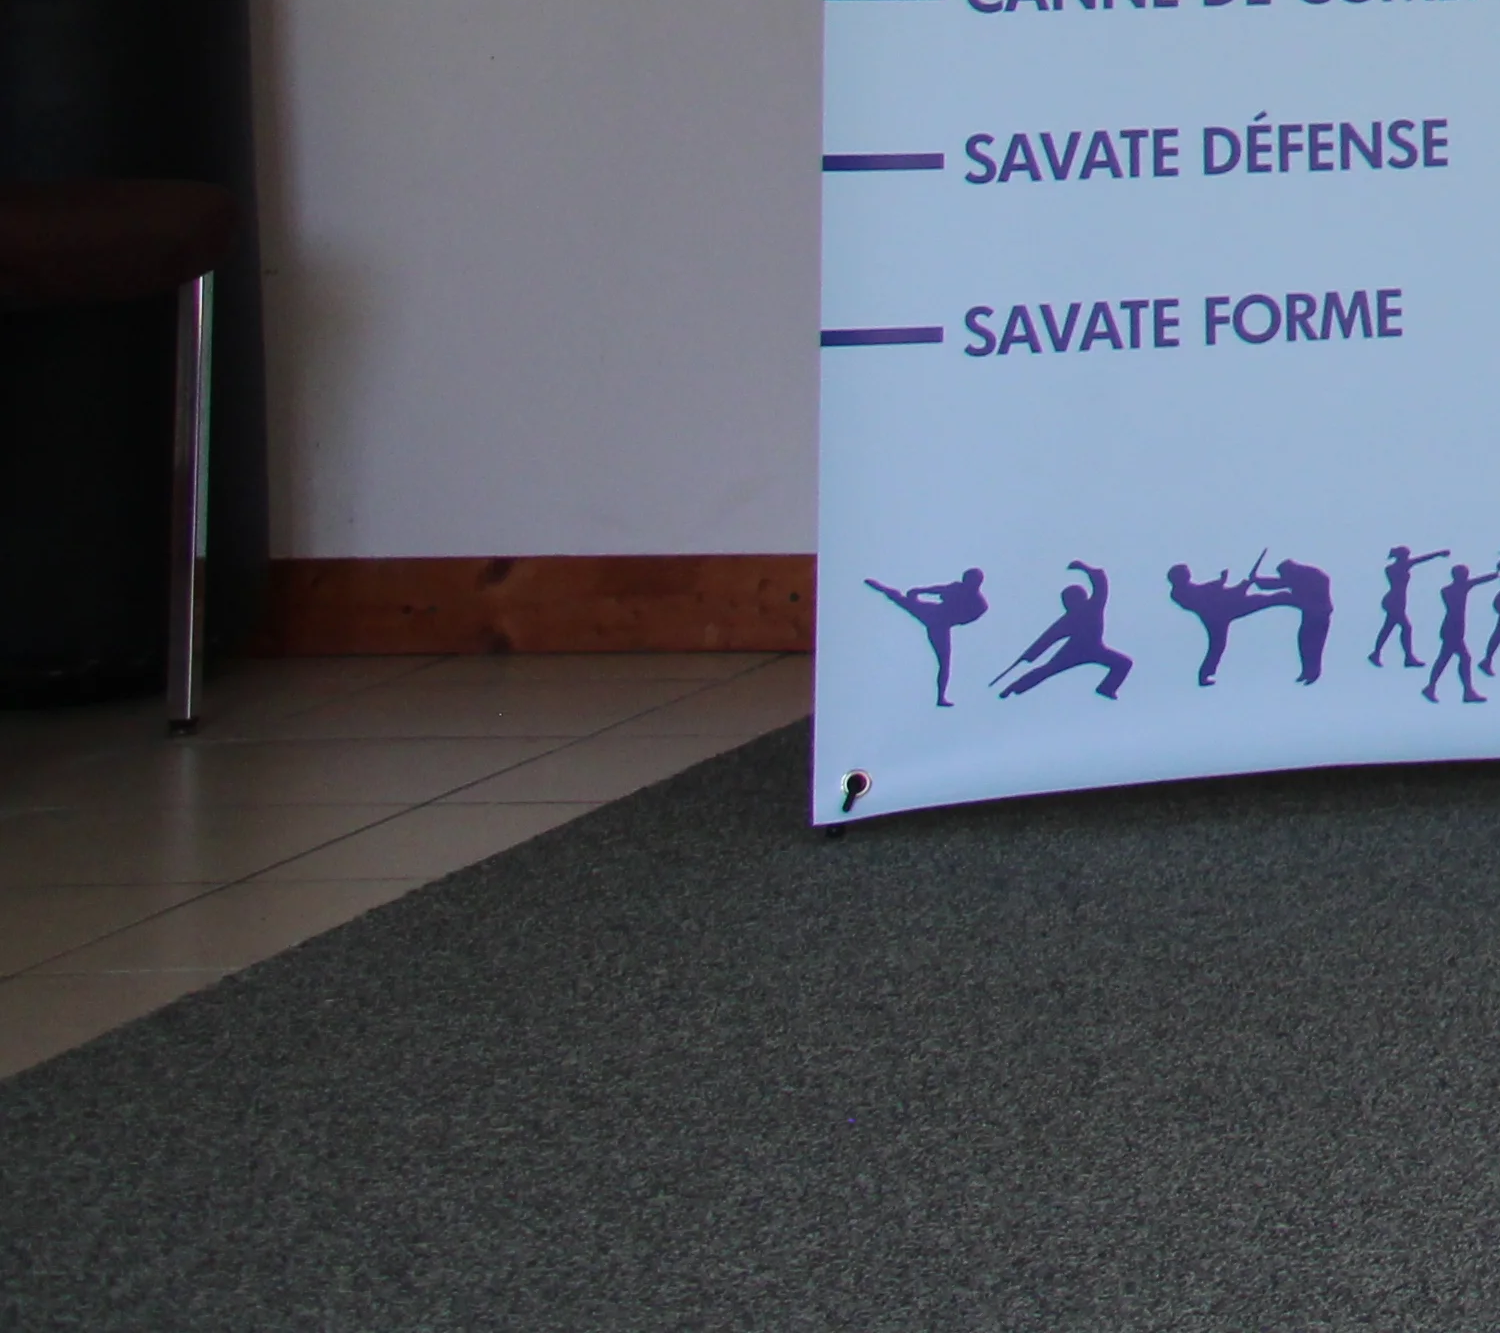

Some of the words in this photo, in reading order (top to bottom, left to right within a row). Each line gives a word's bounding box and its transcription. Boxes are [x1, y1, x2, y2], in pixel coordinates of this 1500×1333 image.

[965, 129, 1178, 184] SAVATE
[1203, 111, 1448, 175] DÉFENSE
[964, 299, 1179, 357] SAVATE
[1205, 289, 1402, 345] FORME
